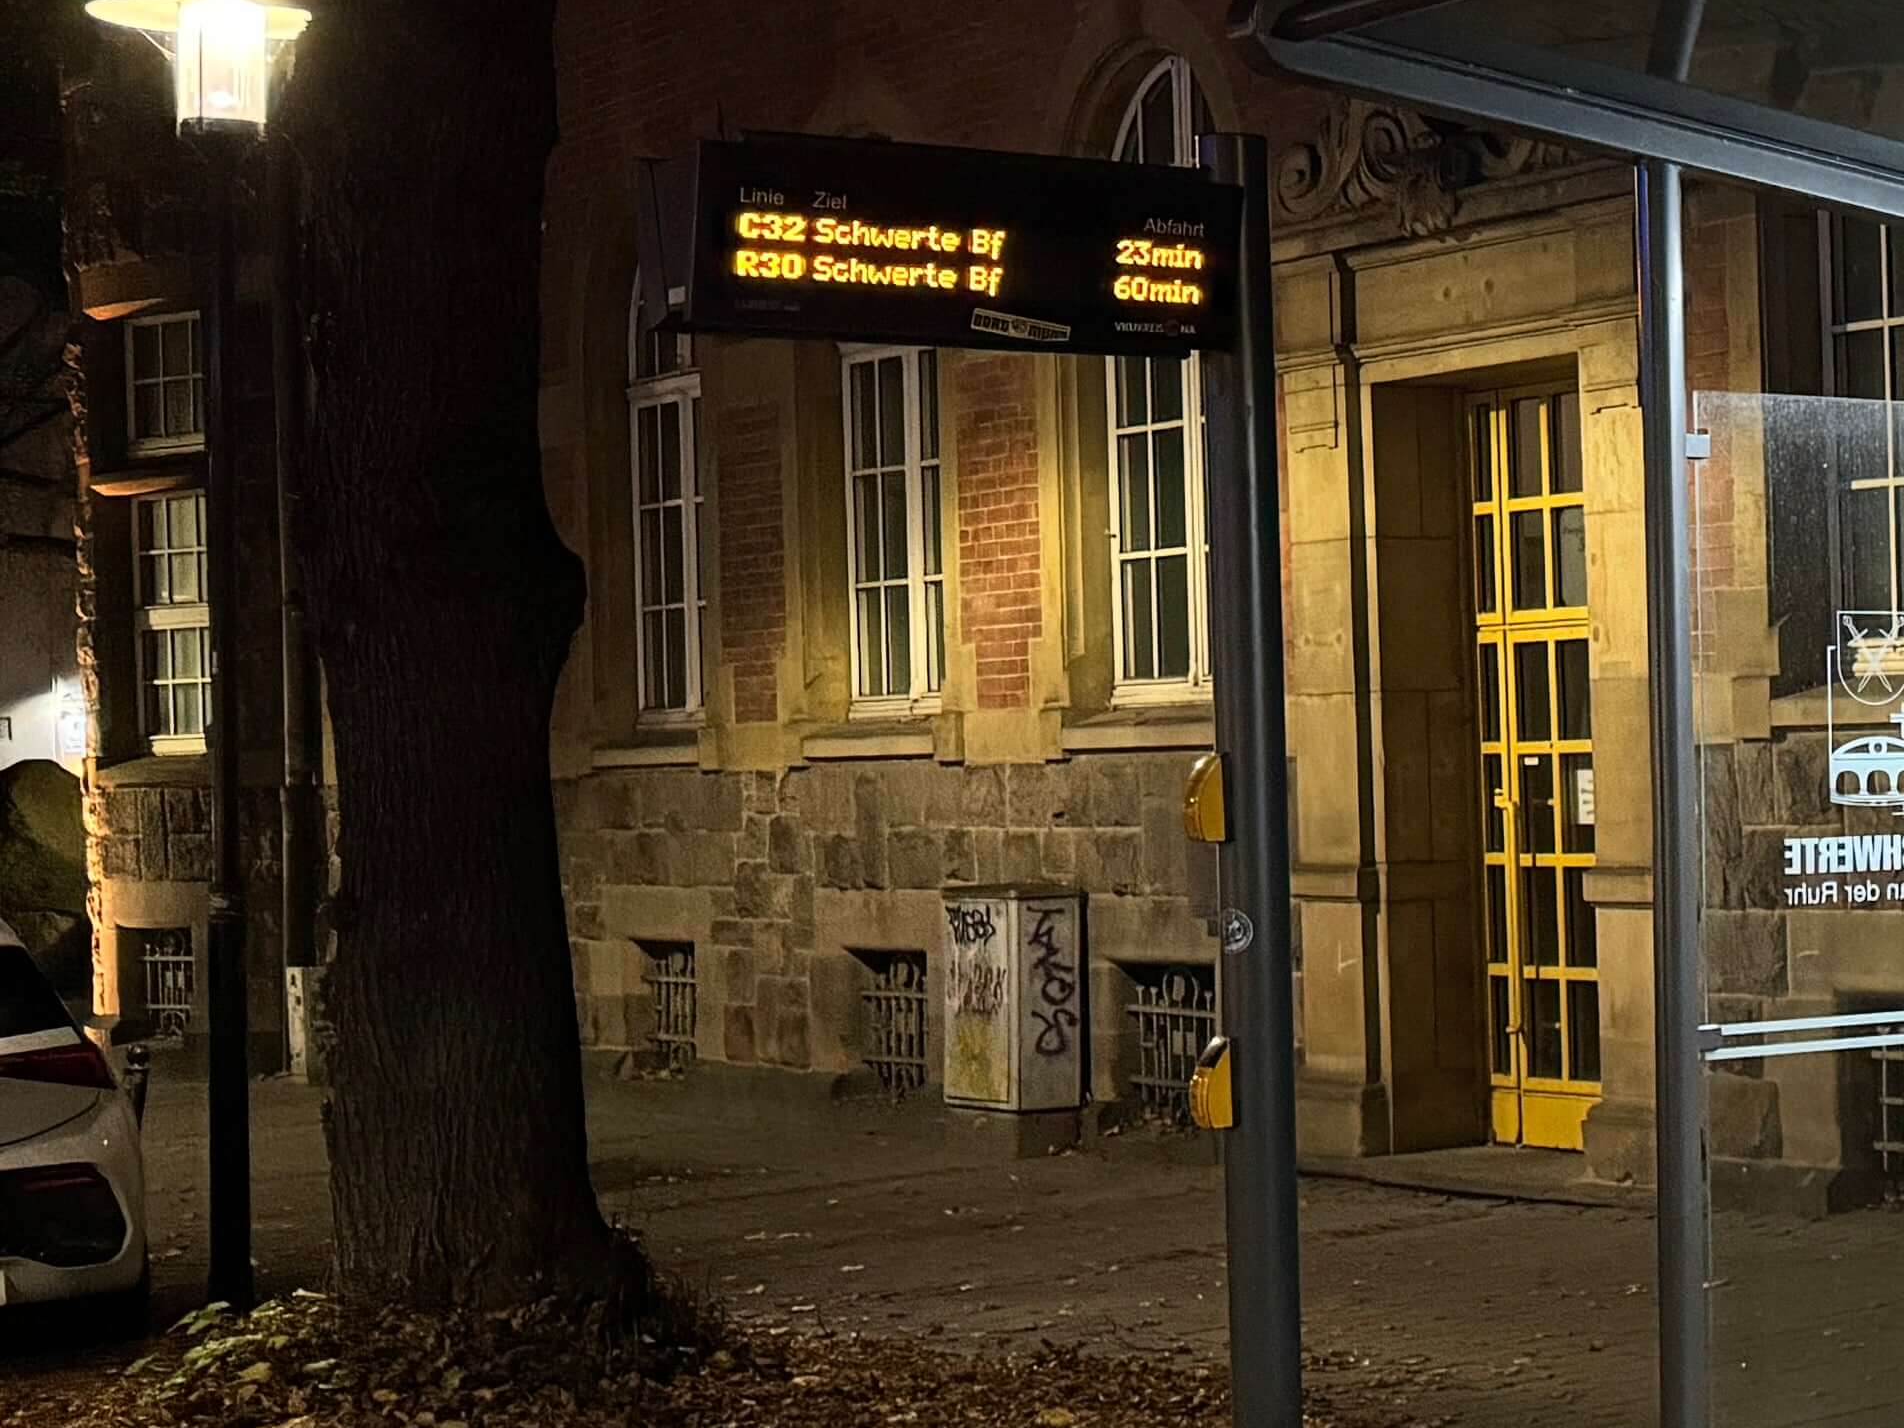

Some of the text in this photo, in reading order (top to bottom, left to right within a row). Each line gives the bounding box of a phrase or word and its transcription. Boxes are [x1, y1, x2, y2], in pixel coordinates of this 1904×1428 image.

[739, 187, 1205, 238] Linie Ziel Abfahrt
[738, 212, 1202, 270] C32 Schwerte Bf 23min
[736, 250, 1201, 305] R30 Schwerte Bf 60min
